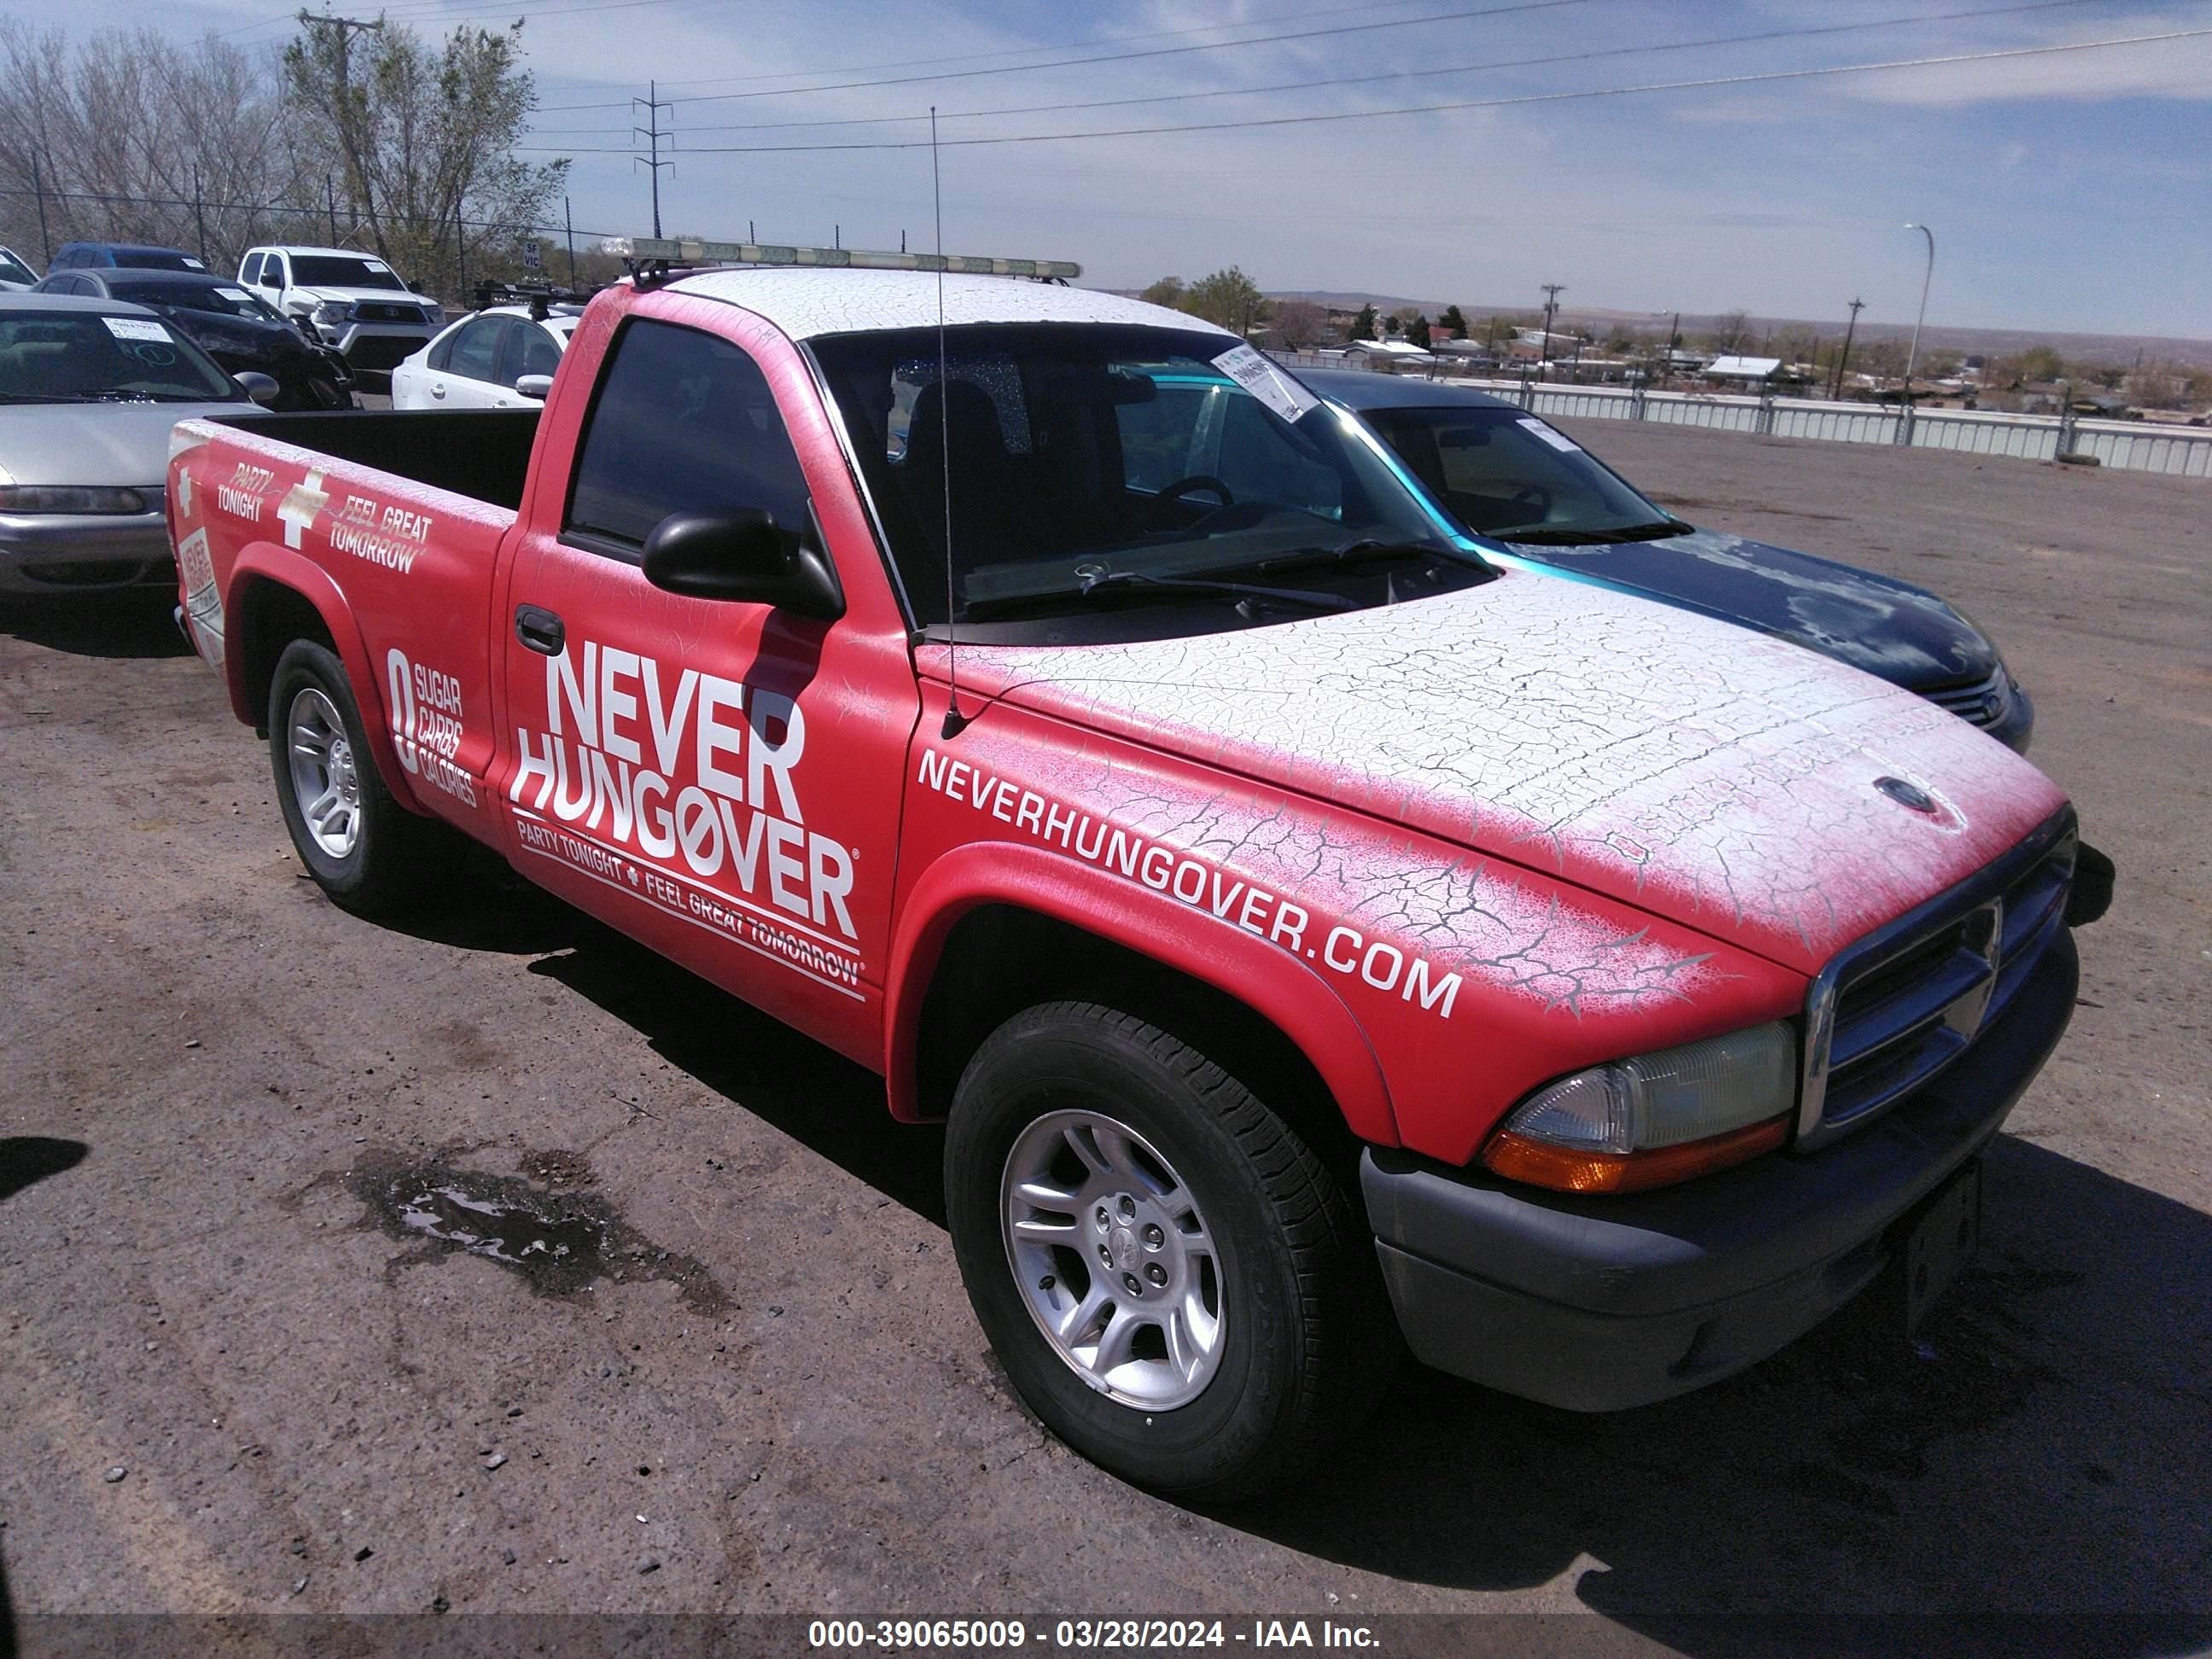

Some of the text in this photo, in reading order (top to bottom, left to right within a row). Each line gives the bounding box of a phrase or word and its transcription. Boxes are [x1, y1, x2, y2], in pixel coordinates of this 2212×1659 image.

[525, 255, 538, 267] VIC
[526, 243, 538, 253] SF
[218, 484, 264, 522] TONIGHT
[229, 463, 275, 493] PARTY
[340, 495, 433, 544] FEEL GREAT
[329, 521, 418, 573] TOMORROW
[387, 649, 418, 775] 0
[414, 663, 463, 717] SUGAR
[417, 707, 463, 759] CARBS
[547, 641, 805, 824] NEVER
[419, 747, 477, 808] CALORIES
[517, 820, 859, 986] PARTY TONIGHT FEEL GREAT TOMORROW
[917, 748, 1463, 1019] NEVERHUNGOVER.COM
